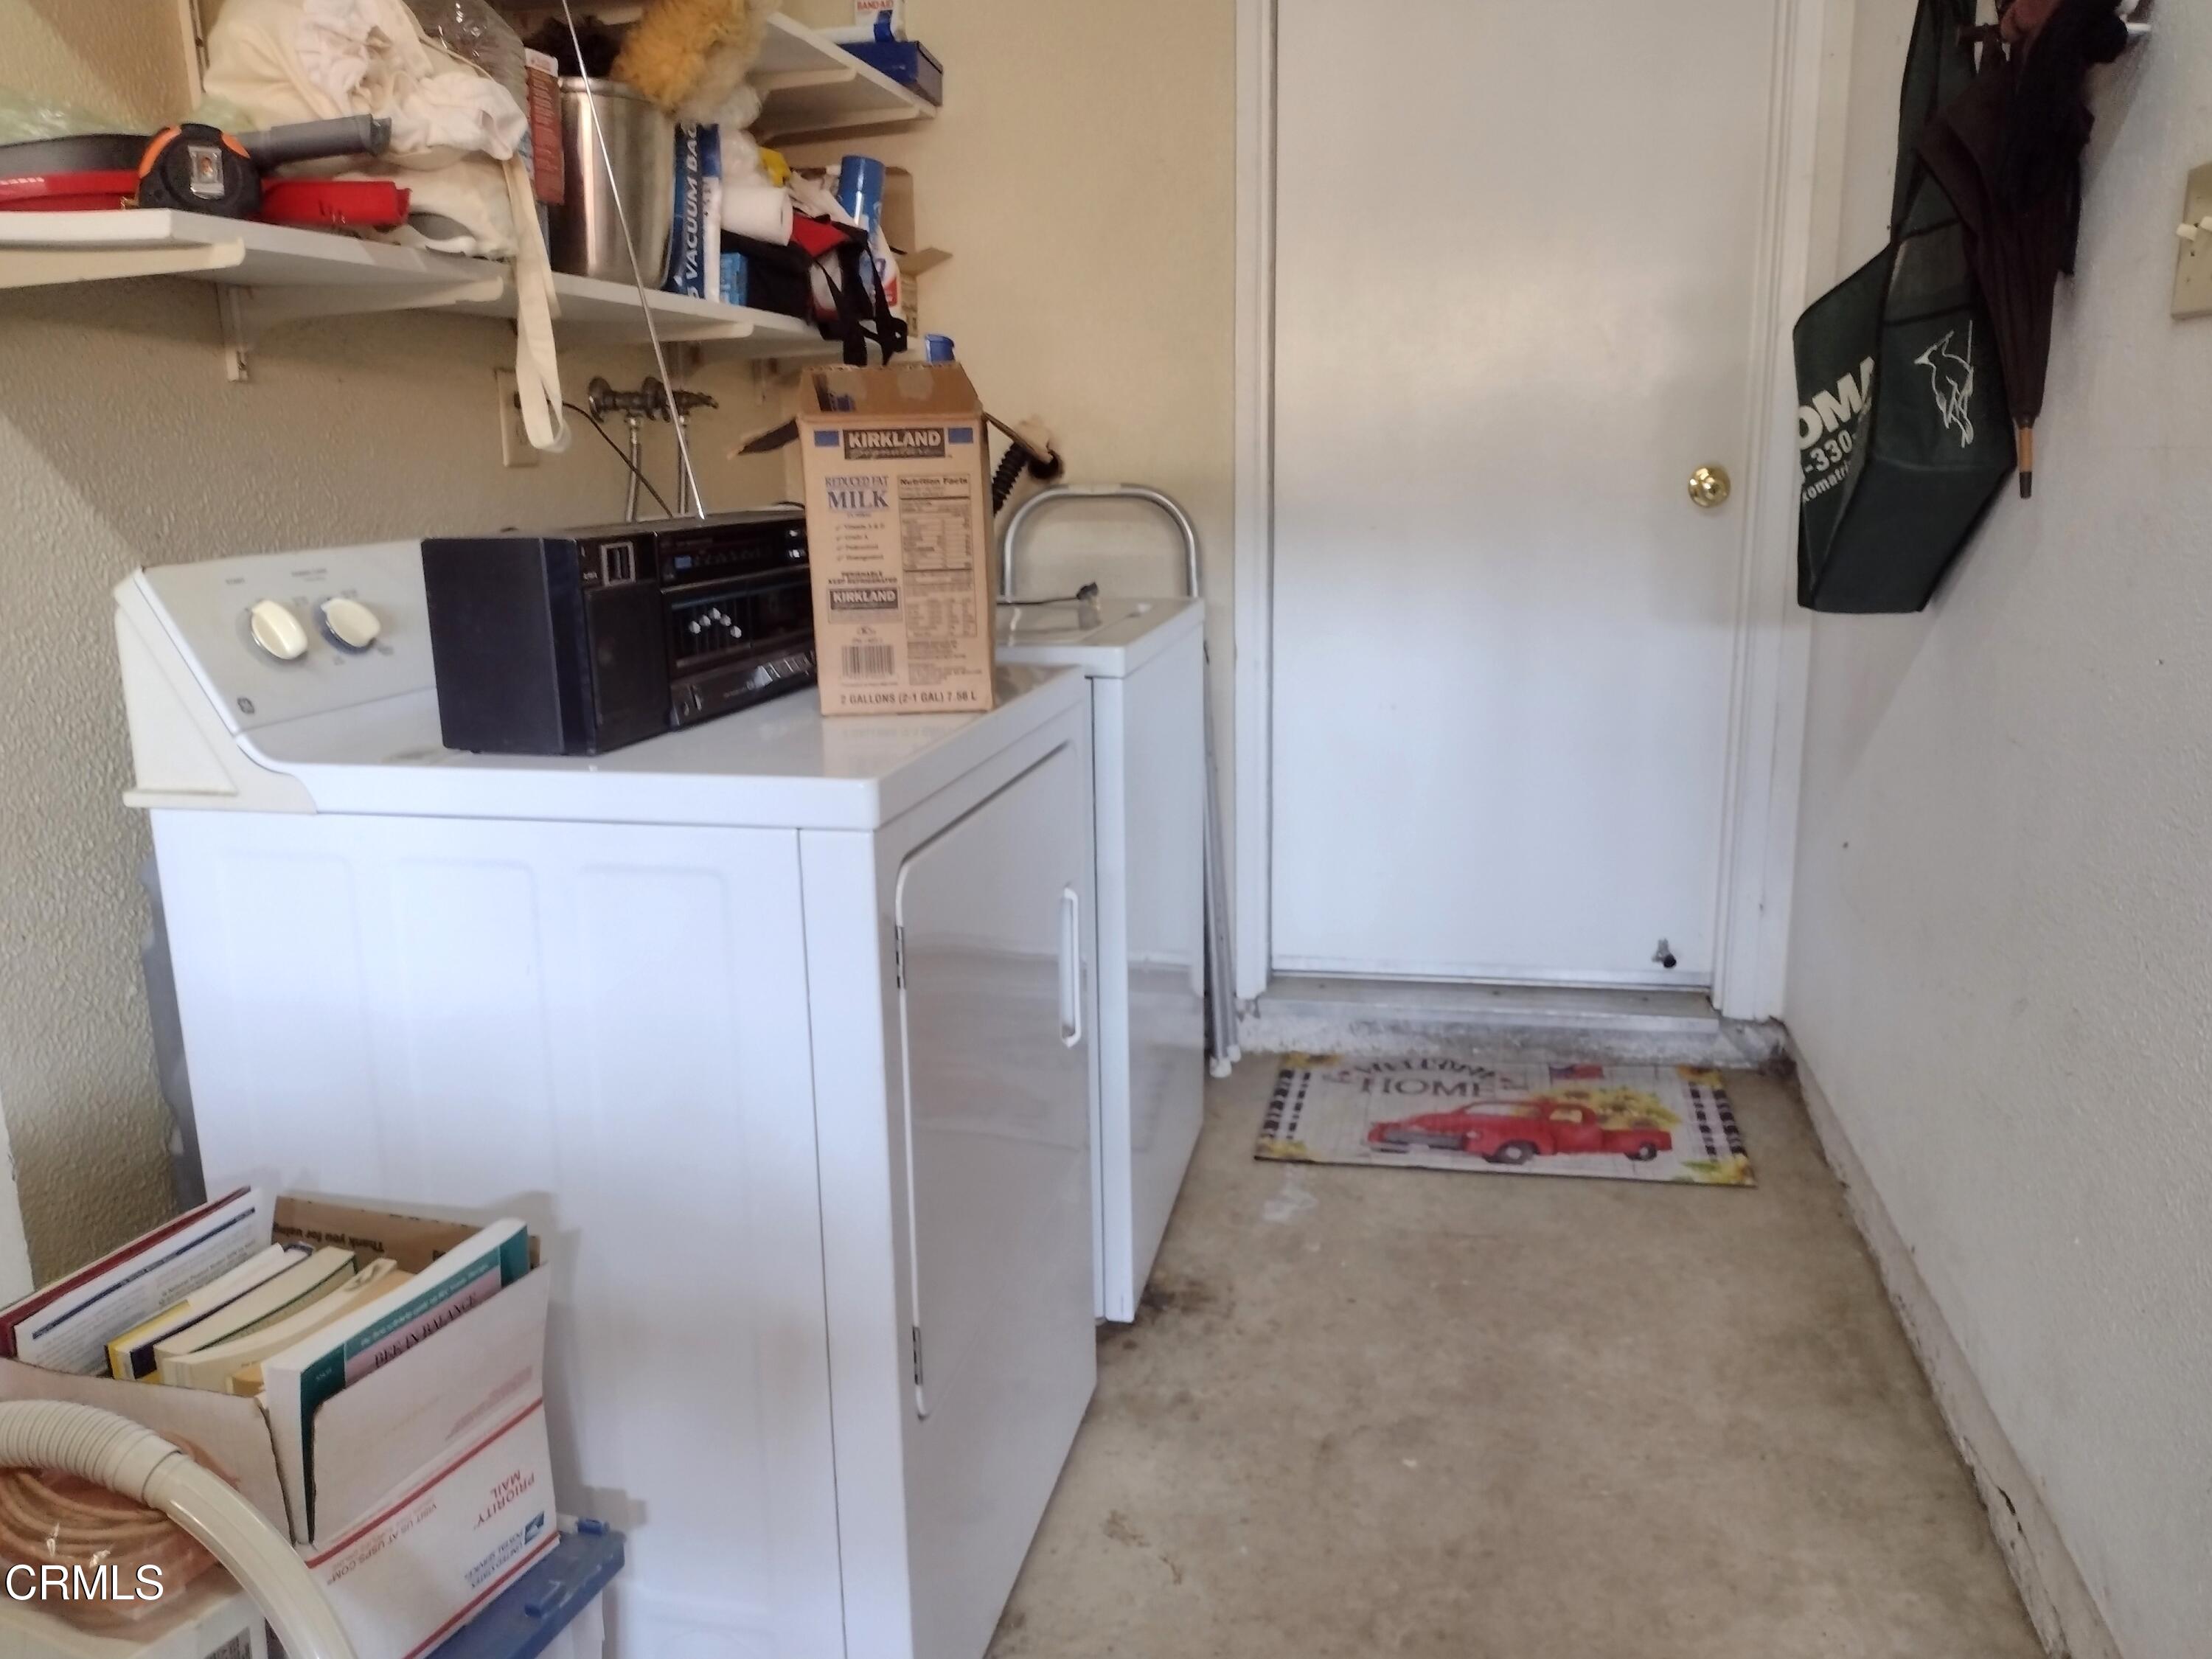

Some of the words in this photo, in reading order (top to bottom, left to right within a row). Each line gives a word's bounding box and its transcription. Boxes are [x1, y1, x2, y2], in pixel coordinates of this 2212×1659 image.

[686, 175, 698, 280] VACUUM
[848, 430, 942, 448] KIRKLAND
[900, 478, 941, 486] Nutrition
[943, 477, 968, 485] Facts
[827, 490, 890, 509] MILK
[832, 591, 897, 603] KIRKLAND
[841, 694, 846, 705] 2
[849, 692, 897, 705] GALLONS
[920, 691, 945, 703] GAL)
[1360, 1076, 1498, 1098] HOME
[306, 1229, 322, 1242] for
[324, 1231, 347, 1245] you
[348, 1237, 385, 1253] Thank
[490, 1470, 522, 1499] MAIL
[476, 1472, 536, 1526] PRIORITY
[400, 1519, 414, 1534] US
[388, 1530, 399, 1544] AT
